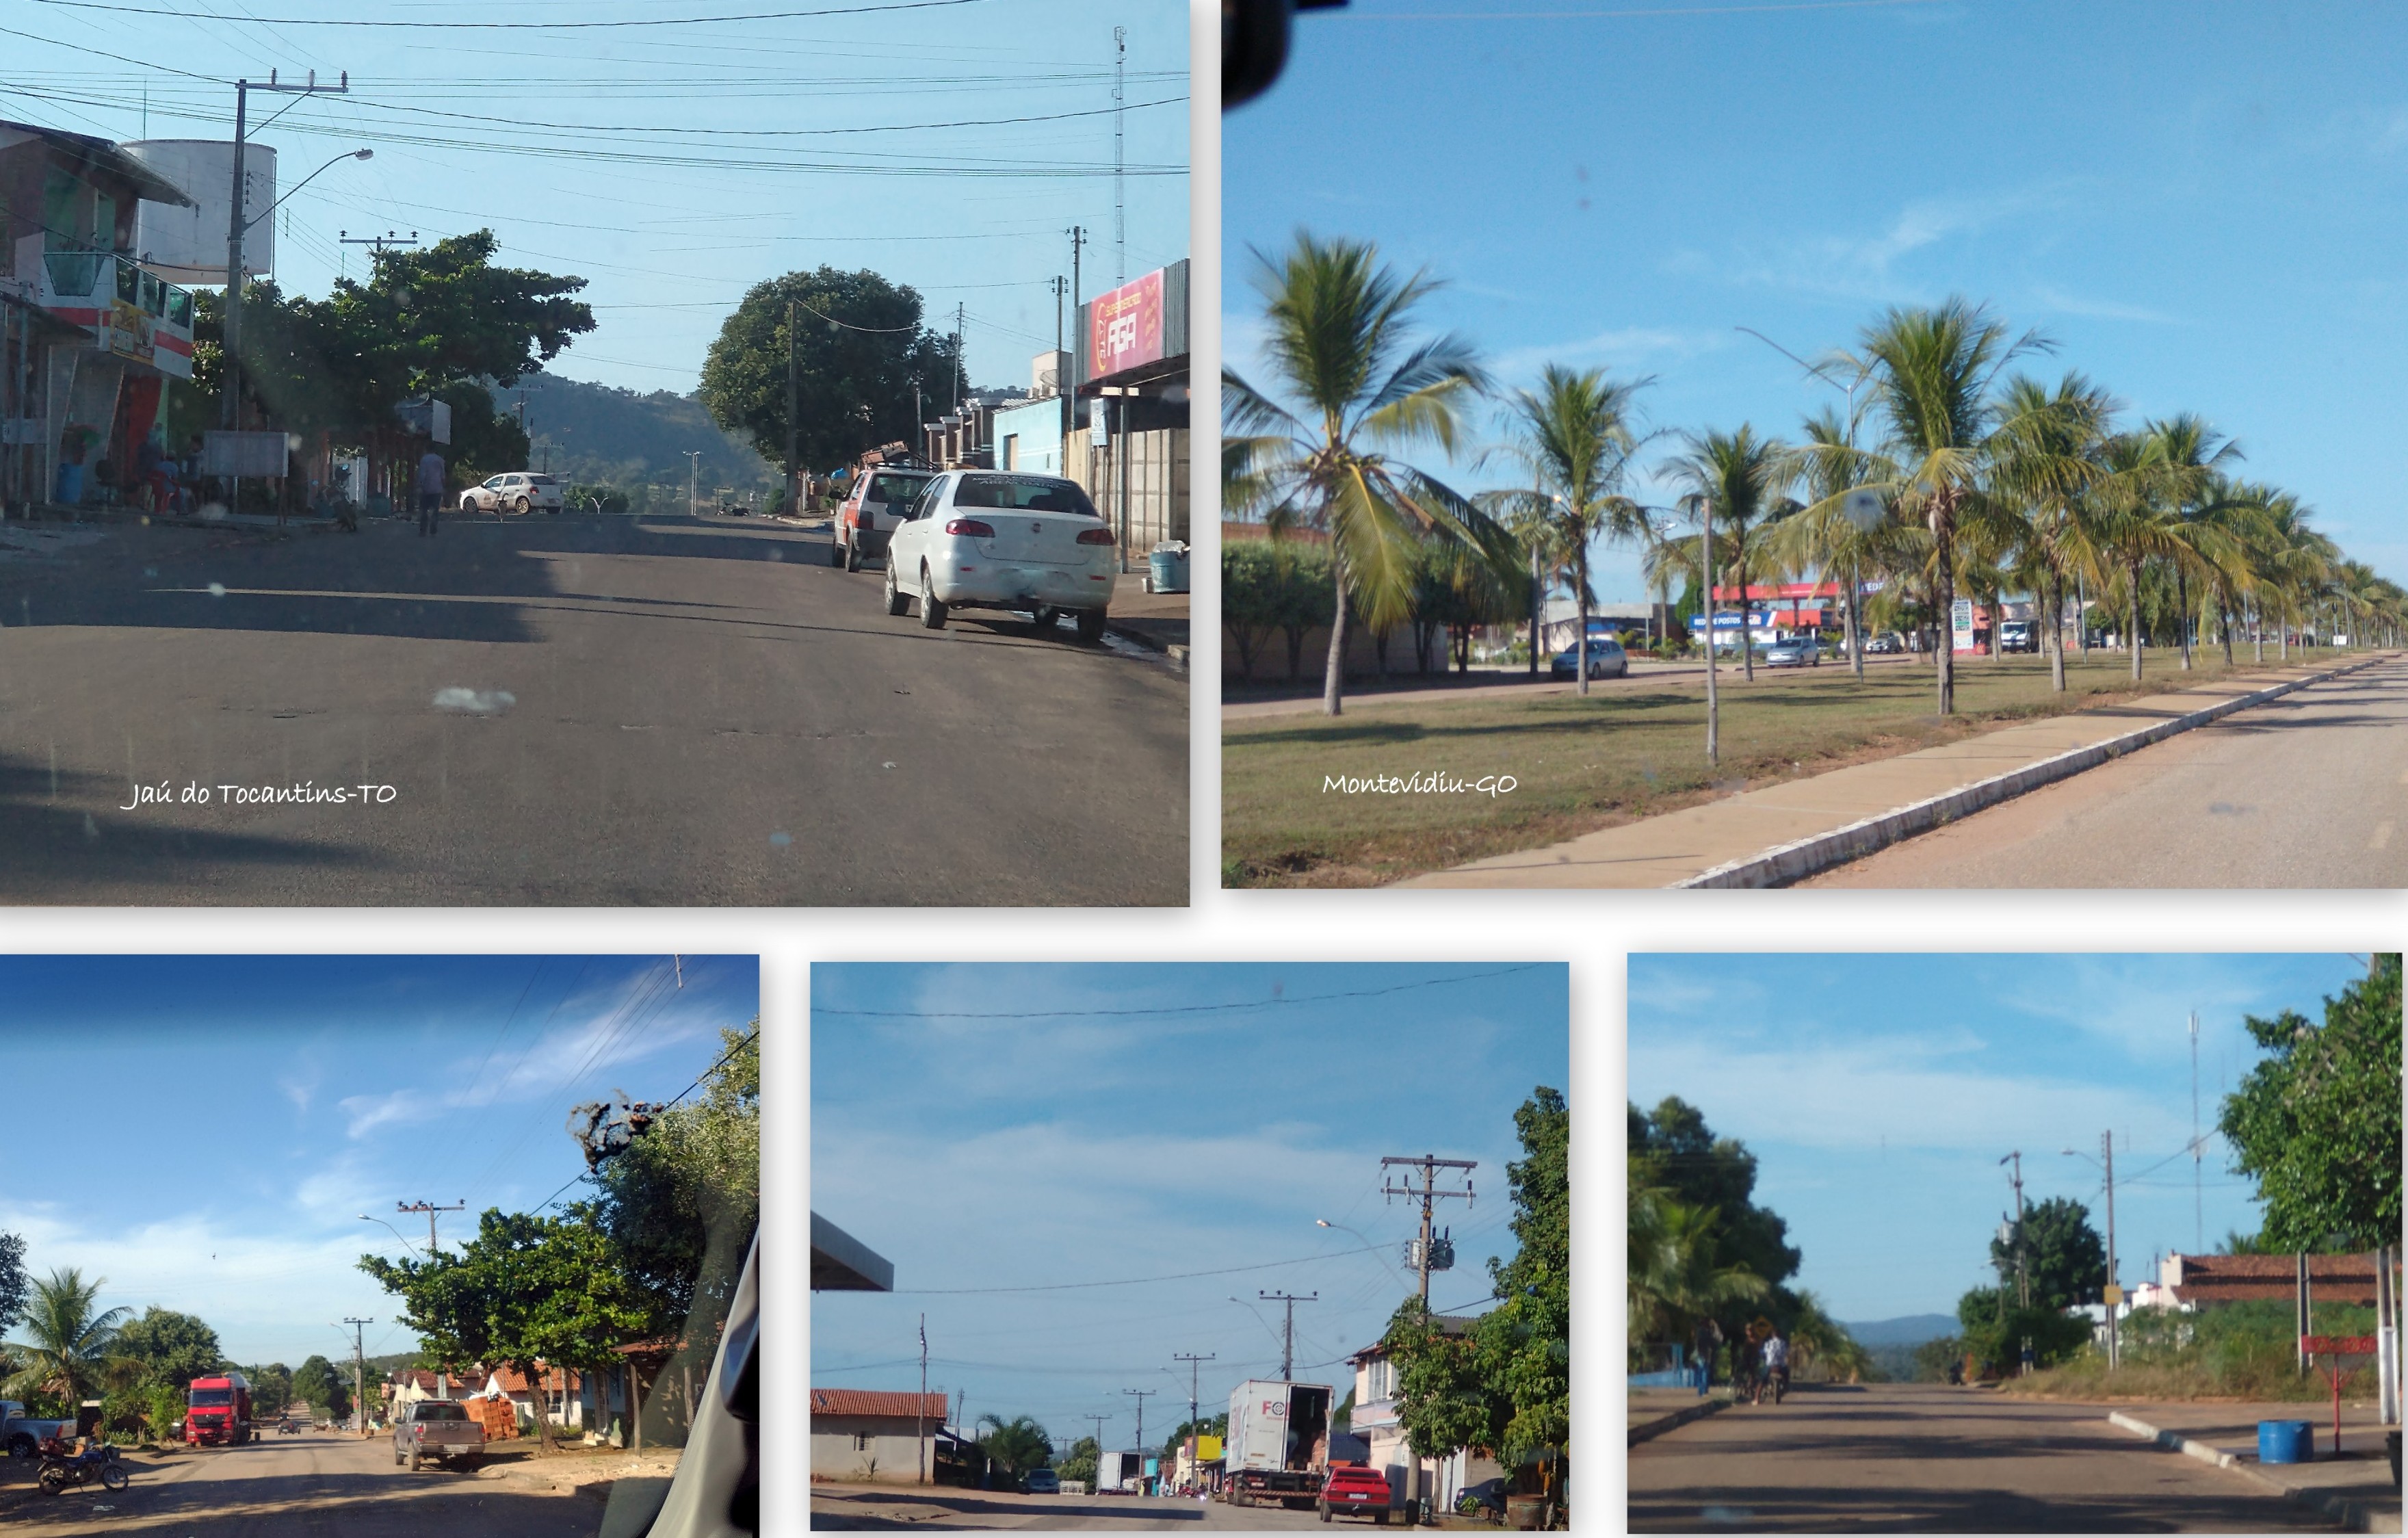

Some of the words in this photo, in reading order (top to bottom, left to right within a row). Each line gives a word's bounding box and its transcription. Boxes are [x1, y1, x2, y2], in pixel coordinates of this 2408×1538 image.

[1108, 313, 1137, 357] AGA
[1694, 618, 1707, 626] RED
[1718, 616, 1741, 625] POSTOS
